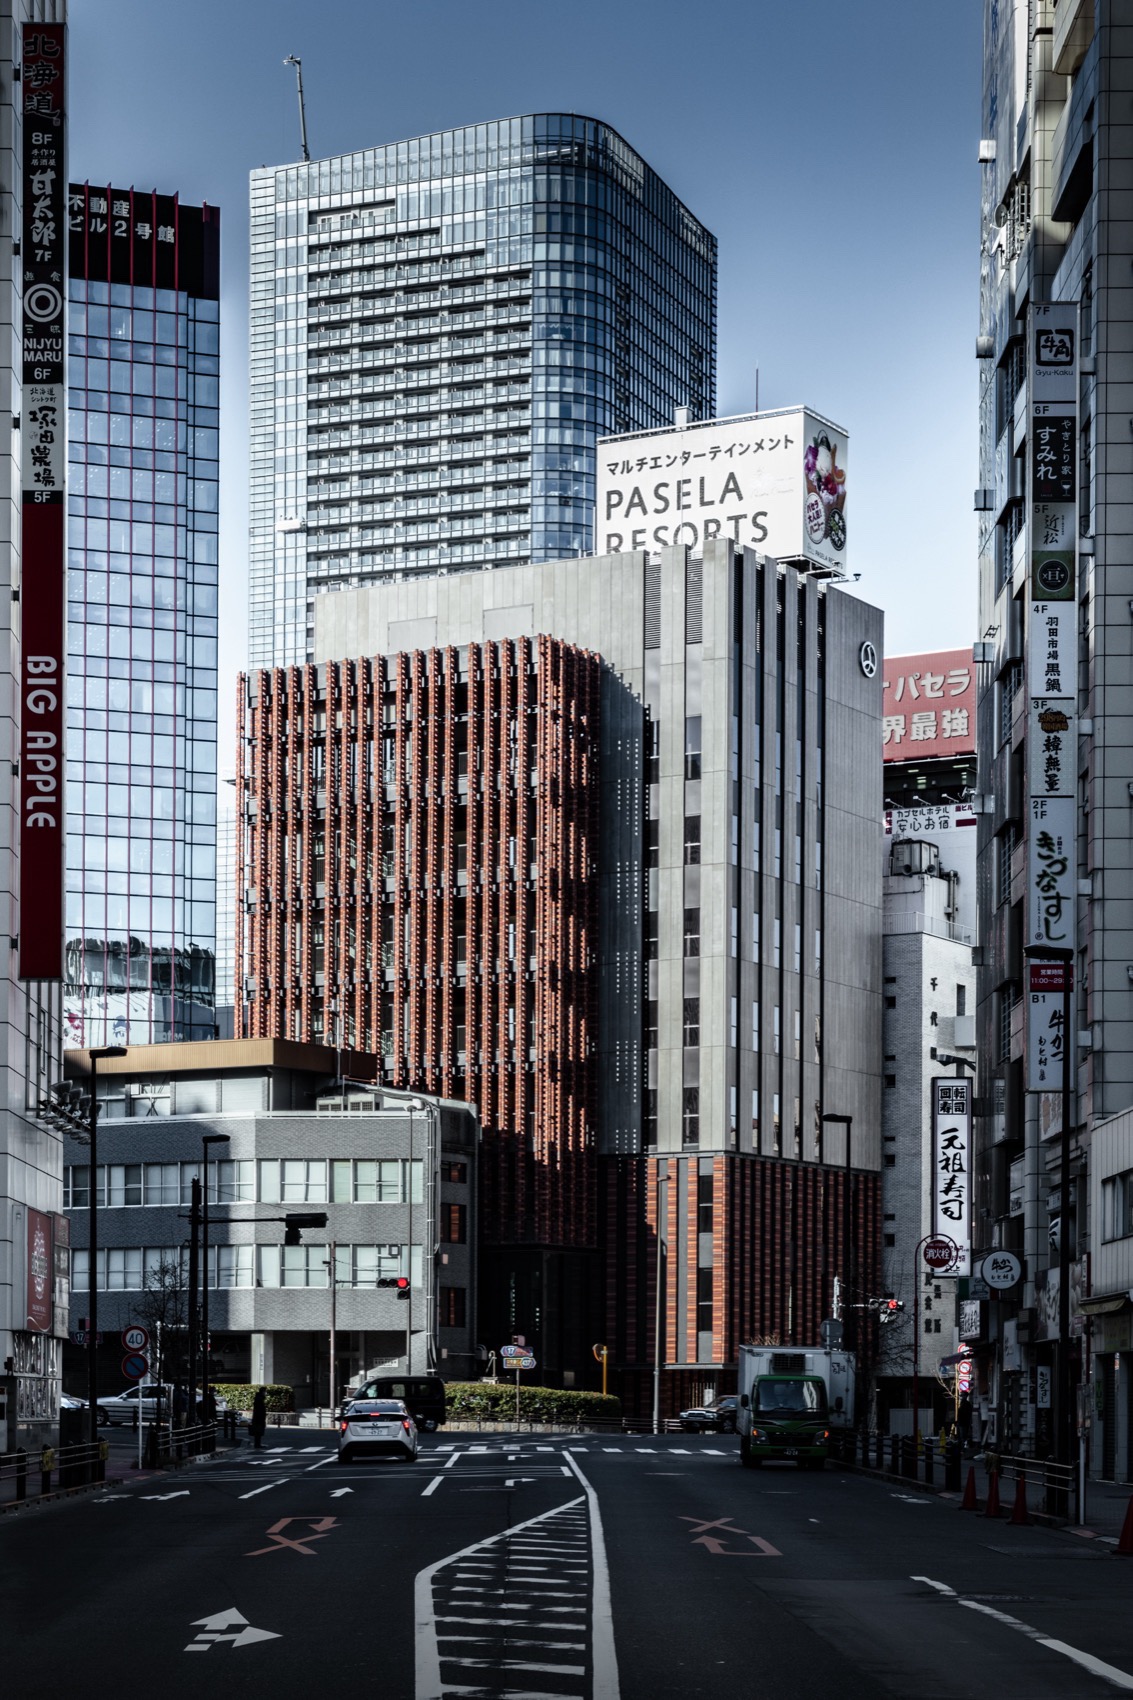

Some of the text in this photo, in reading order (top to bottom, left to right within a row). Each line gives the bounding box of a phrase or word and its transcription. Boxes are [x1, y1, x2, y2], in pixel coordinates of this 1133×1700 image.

[24, 33, 61, 122] 北海道
[32, 132, 53, 145] 8F
[30, 168, 57, 247] 甘太郎
[69, 216, 175, 244] ビル2号館
[34, 250, 52, 262] 7F
[1035, 306, 1050, 316] 7F
[24, 338, 62, 350] NIJYU
[1041, 336, 1070, 358] 牛角
[24, 351, 61, 362] MARU
[34, 368, 51, 380] 6F
[1035, 370, 1073, 378] Gyu-Kaku
[1035, 406, 1049, 414] 6F
[29, 405, 57, 487] 塚田農場
[1036, 426, 1058, 480] すみれ
[34, 492, 51, 503] 5F
[606, 472, 744, 520] PASELA
[1034, 505, 1049, 514] 5F
[606, 511, 768, 556] RESORTS
[1043, 514, 1060, 545] 近松
[1033, 605, 1048, 613] 4F
[1046, 616, 1059, 660] 羽田市場
[883, 668, 971, 702] パセラ
[1033, 701, 1047, 709] 3F
[26, 655, 58, 829] BIG APPLE
[1033, 800, 1047, 809] 2F
[1034, 811, 1047, 820] 1F
[897, 815, 950, 832] 安心お宿
[1036, 830, 1071, 941] きづなすし
[1032, 994, 1046, 1003] B1
[940, 1087, 965, 1100] 回転
[940, 1101, 965, 1113] 寿司
[938, 1127, 967, 1220] 元祖寿司
[926, 1248, 951, 1259] 消火栓
[128, 1333, 143, 1345] 40
